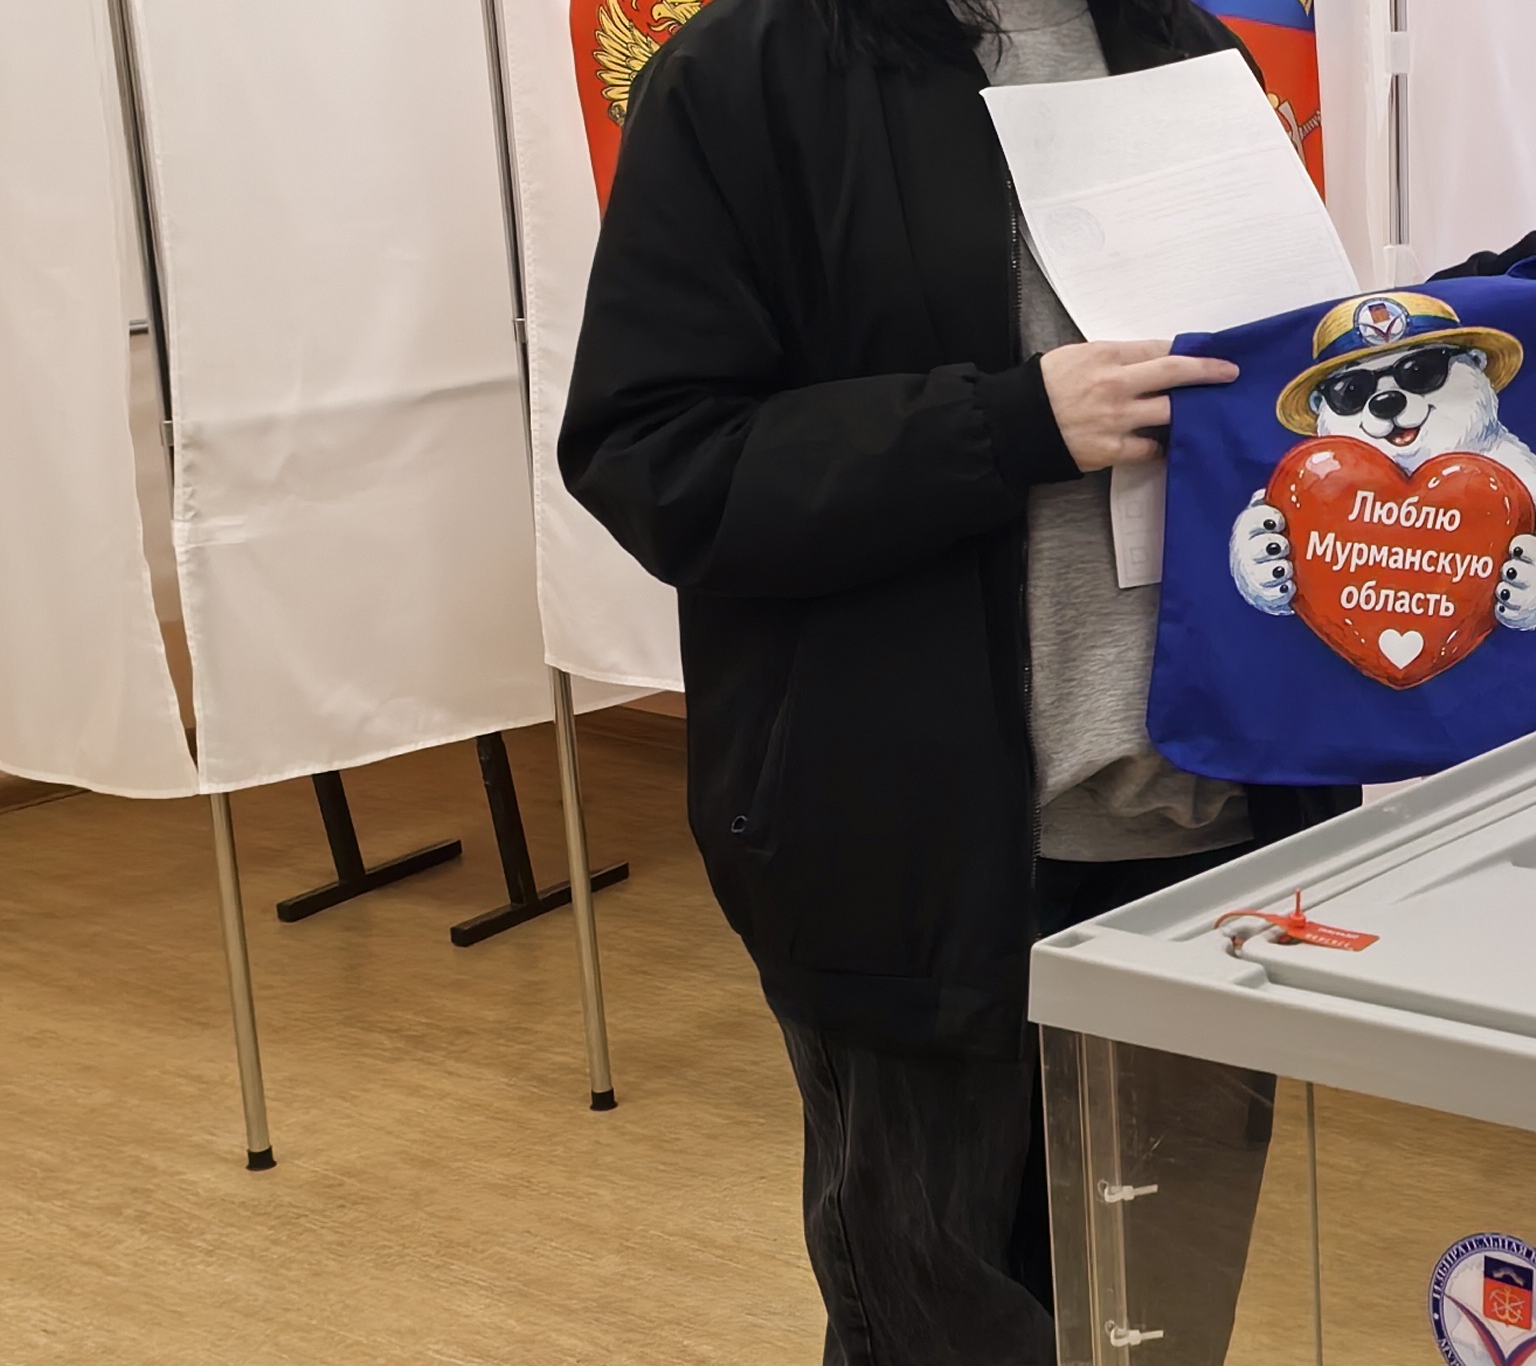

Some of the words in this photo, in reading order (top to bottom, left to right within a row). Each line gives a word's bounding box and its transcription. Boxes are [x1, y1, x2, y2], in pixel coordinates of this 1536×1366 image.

[1348, 490, 1461, 533] Люблю
[1305, 531, 1494, 581] Мурманскую
[1340, 580, 1455, 619] область
[1432, 1236, 1528, 1300] ИЗБИРАТЕЛЬНАЯ
